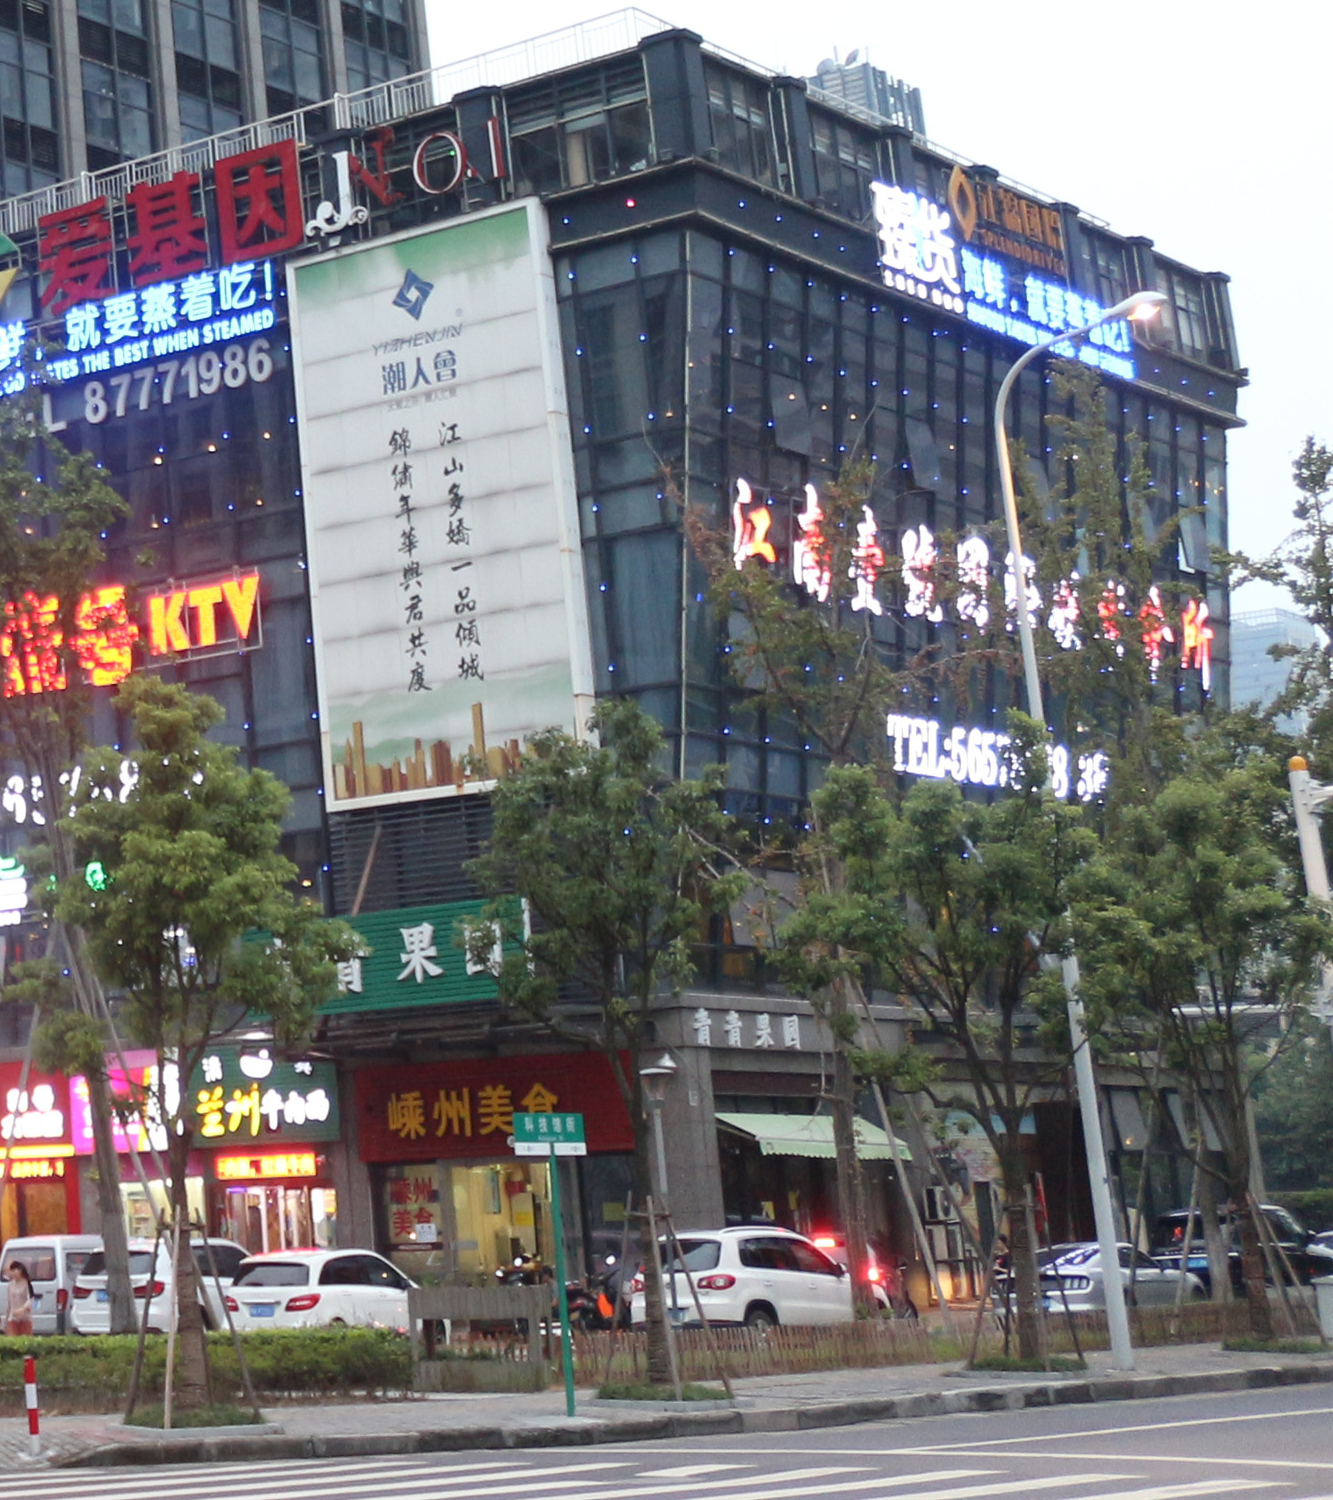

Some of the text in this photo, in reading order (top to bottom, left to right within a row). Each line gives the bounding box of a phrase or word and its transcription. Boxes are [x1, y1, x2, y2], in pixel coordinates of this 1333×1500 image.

[37, 139, 304, 317] 爱基因
[81, 348, 111, 375] THE
[114, 338, 150, 367] BEST
[152, 327, 200, 358] WHEN
[202, 307, 276, 344] STEAMED
[381, 349, 457, 396] 潮人會
[147, 572, 261, 658] KTV
